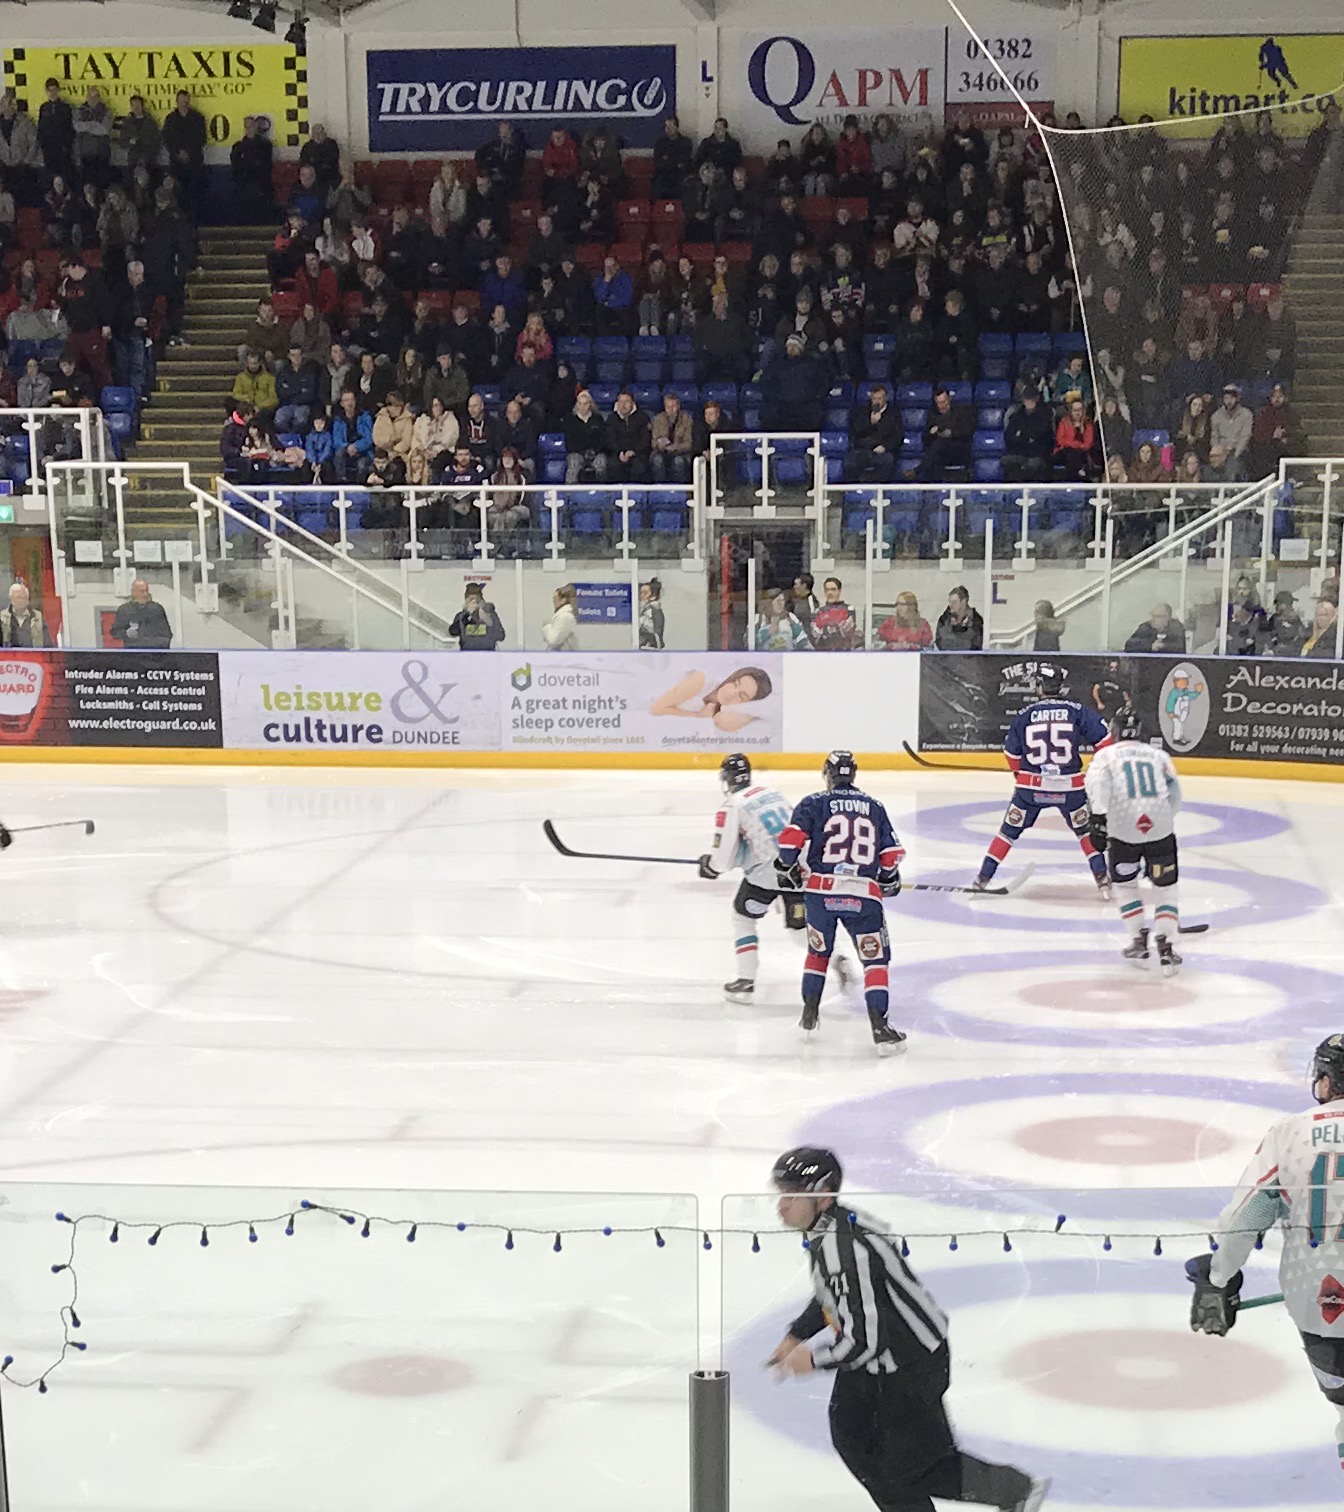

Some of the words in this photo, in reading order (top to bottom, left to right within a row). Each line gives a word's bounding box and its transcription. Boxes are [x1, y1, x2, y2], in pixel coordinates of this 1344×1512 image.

[966, 38, 1034, 60] 01382
[55, 52, 128, 80] TAY
[139, 50, 255, 79] TAXIS
[701, 60, 714, 84] L
[958, 71, 1040, 93] 346666
[376, 78, 630, 114] TRYCURLING
[992, 582, 1008, 605] L
[65, 669, 104, 680] Intruder
[105, 670, 139, 680] Alarms
[146, 670, 172, 681] CCTV
[173, 670, 215, 682] Systems
[537, 672, 600, 688] dovetail
[75, 685, 93, 695] Fire
[95, 685, 128, 696] Alarms
[136, 685, 169, 696] Access
[170, 685, 206, 697] Control
[260, 684, 382, 713] leisure
[390, 659, 460, 724] &
[79, 700, 134, 711] Locksmiths
[141, 700, 161, 711] Call
[162, 700, 203, 712] Systems
[511, 697, 523, 711] A
[525, 697, 570, 714] great
[571, 695, 628, 712] night's
[67, 716, 217, 733] www.electroguard.co.uk
[512, 714, 555, 732] sleep
[557, 713, 622, 729] covered
[1030, 709, 1069, 723] CARTER
[262, 716, 383, 744] culture
[392, 730, 460, 745] DUNDEE
[1218, 723, 1250, 738] 01382
[1025, 723, 1074, 766] 55
[1229, 740, 1245, 752] For
[1246, 741, 1259, 753] all
[1259, 743, 1280, 755] your
[1281, 743, 1328, 758] decorating
[1122, 760, 1157, 800] 10
[829, 799, 871, 816] STOVIN
[821, 813, 878, 866] 28
